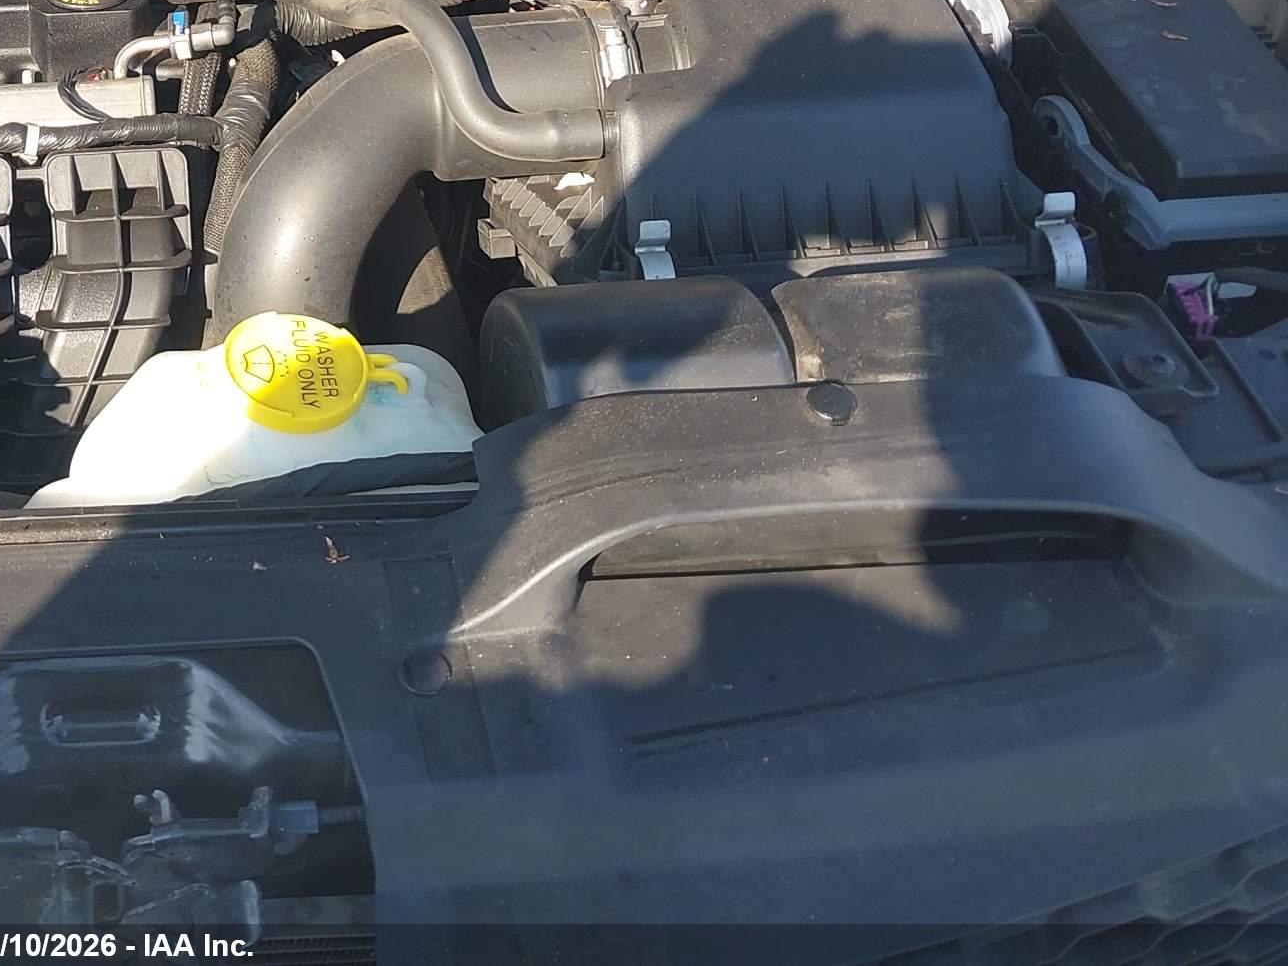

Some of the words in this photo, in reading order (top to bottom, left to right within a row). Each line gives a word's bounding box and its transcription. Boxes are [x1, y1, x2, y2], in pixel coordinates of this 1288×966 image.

[290, 319, 312, 364] FLUID
[313, 331, 340, 399] WASHER
[297, 368, 321, 410] ONLY
